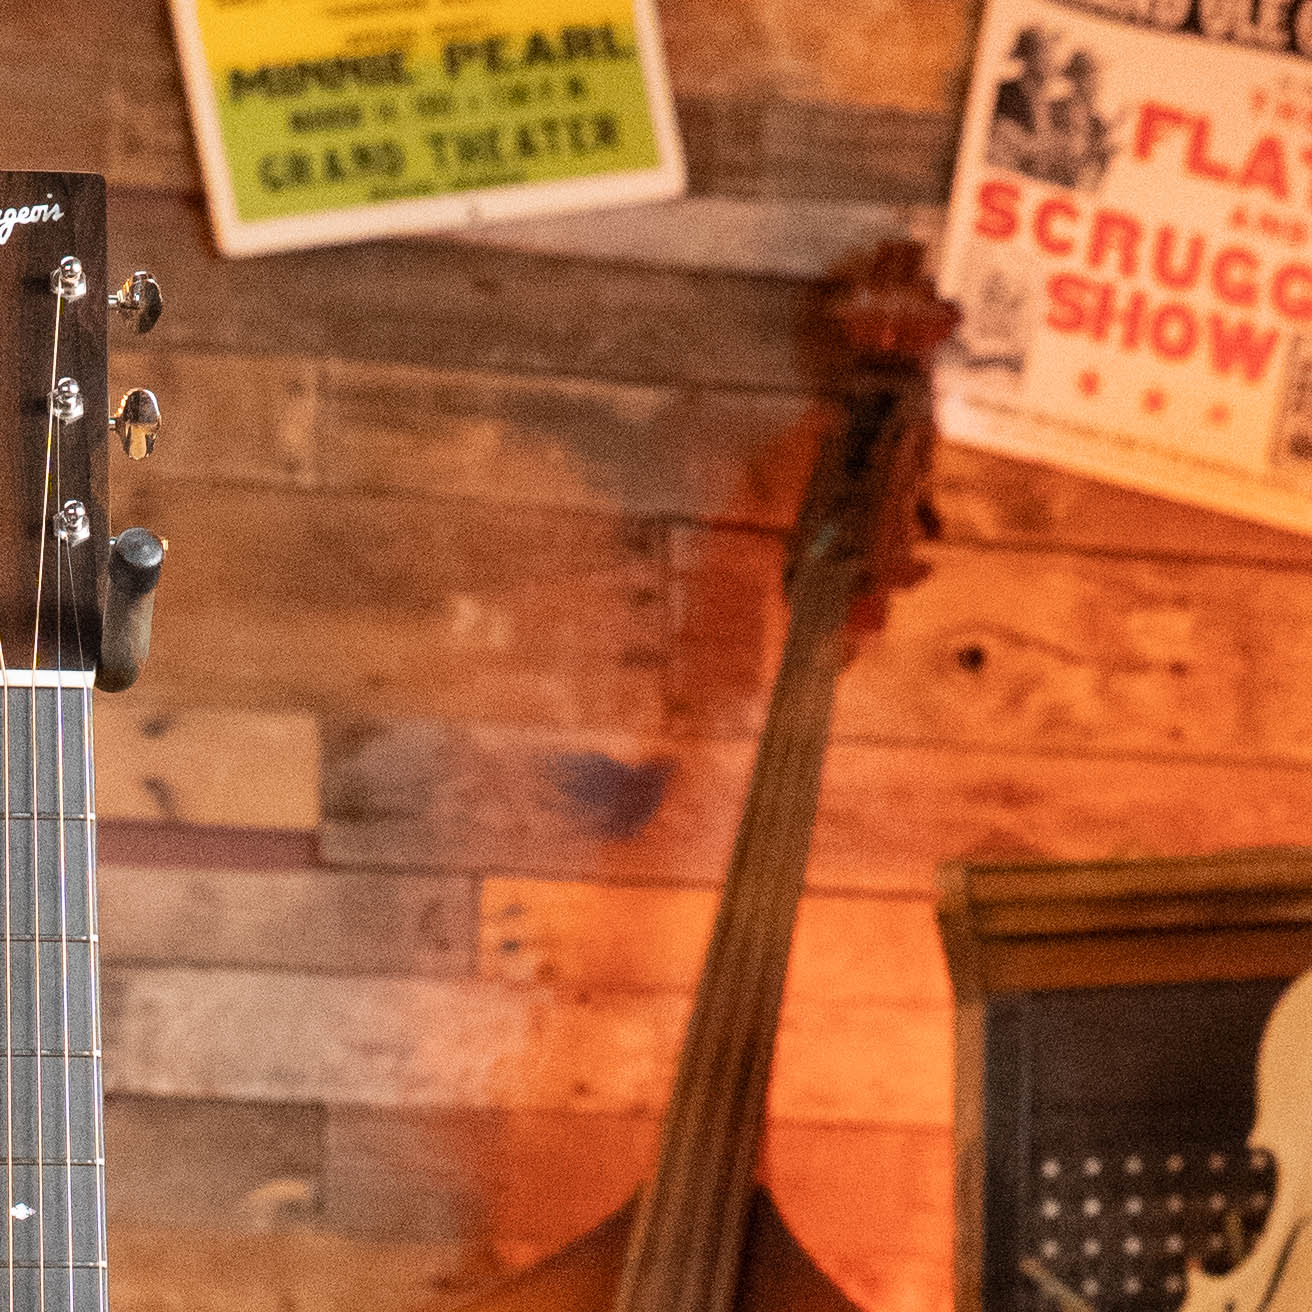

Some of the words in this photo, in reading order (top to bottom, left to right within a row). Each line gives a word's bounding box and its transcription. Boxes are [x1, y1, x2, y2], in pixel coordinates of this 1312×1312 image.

[226, 51, 407, 99] MINNIE
[444, 26, 628, 78] PEARL
[258, 141, 406, 193] GRAND
[425, 111, 620, 172] THEATER
[1132, 101, 1312, 205] FLA
[1045, 271, 1281, 384] SHOW
